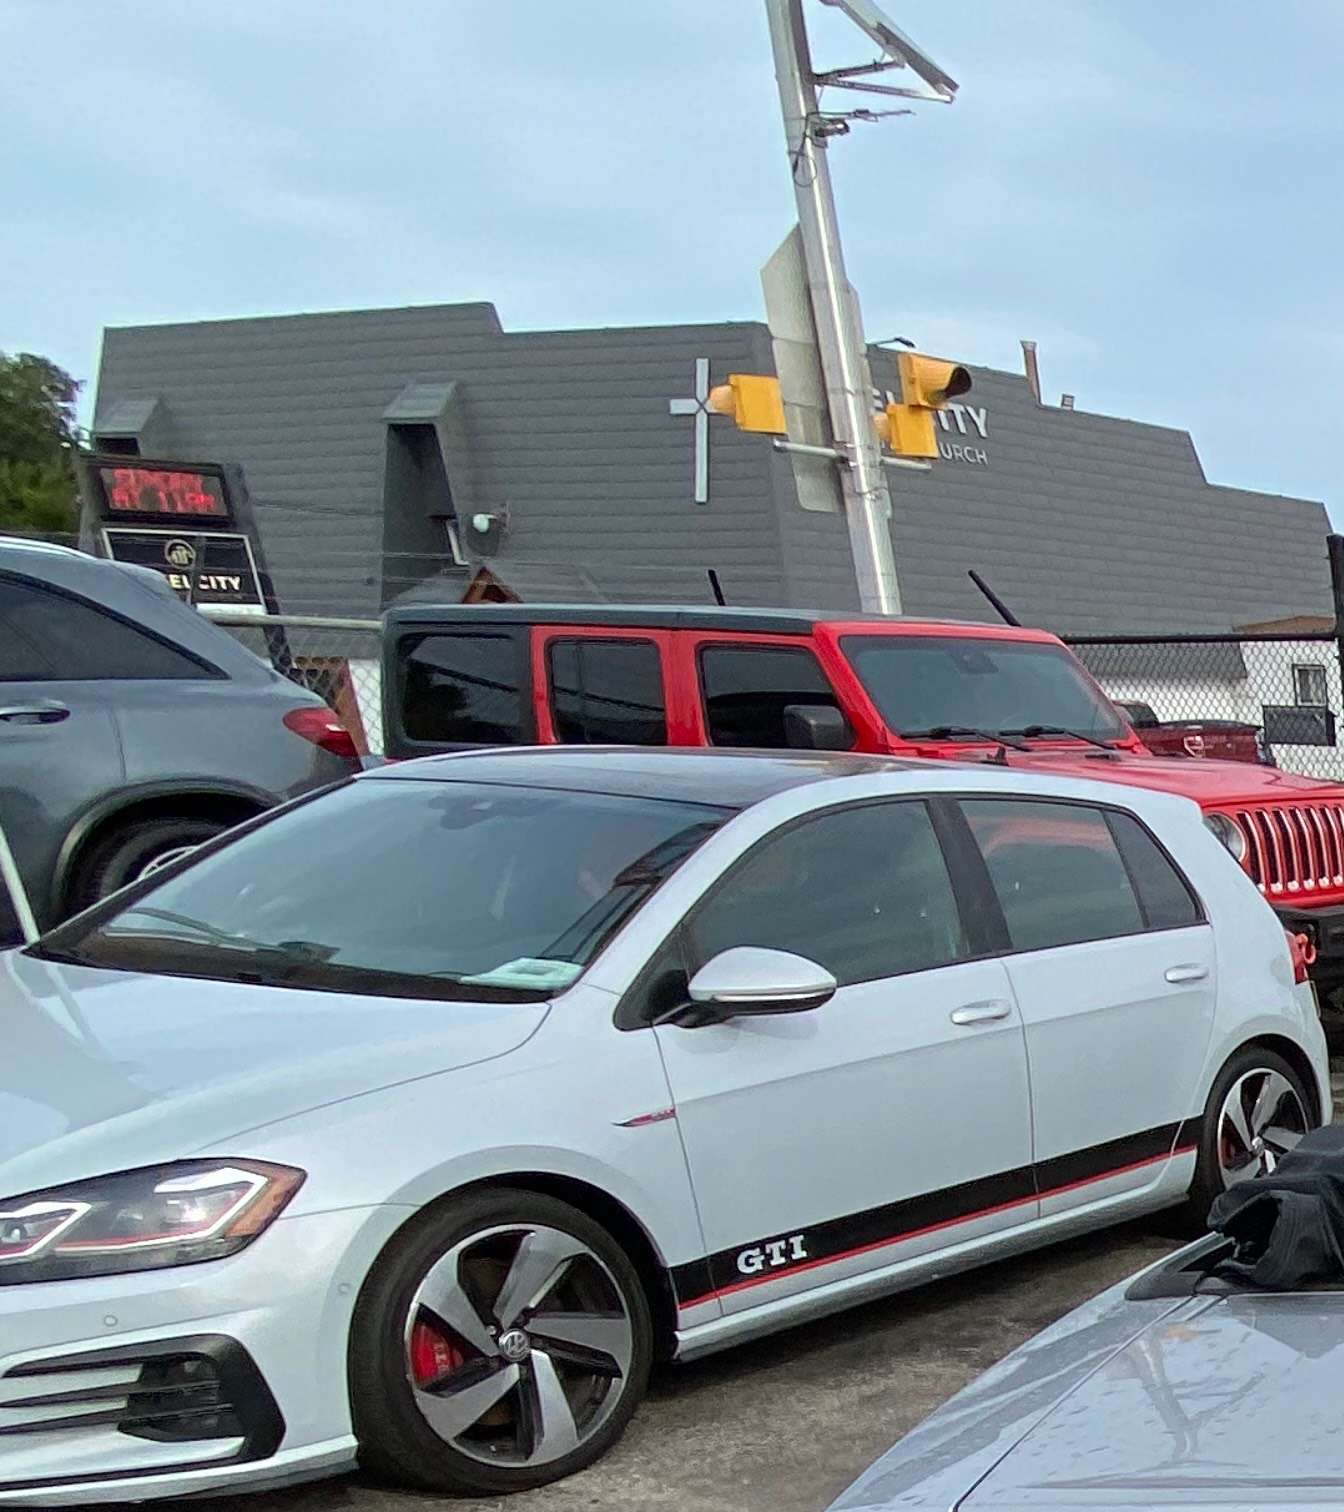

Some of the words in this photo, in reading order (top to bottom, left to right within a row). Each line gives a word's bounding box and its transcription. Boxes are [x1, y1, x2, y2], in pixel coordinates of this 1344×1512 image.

[935, 402, 989, 439] ITY
[938, 441, 989, 465] URCH
[198, 574, 241, 591] CITY
[736, 1234, 808, 1275] GTI
